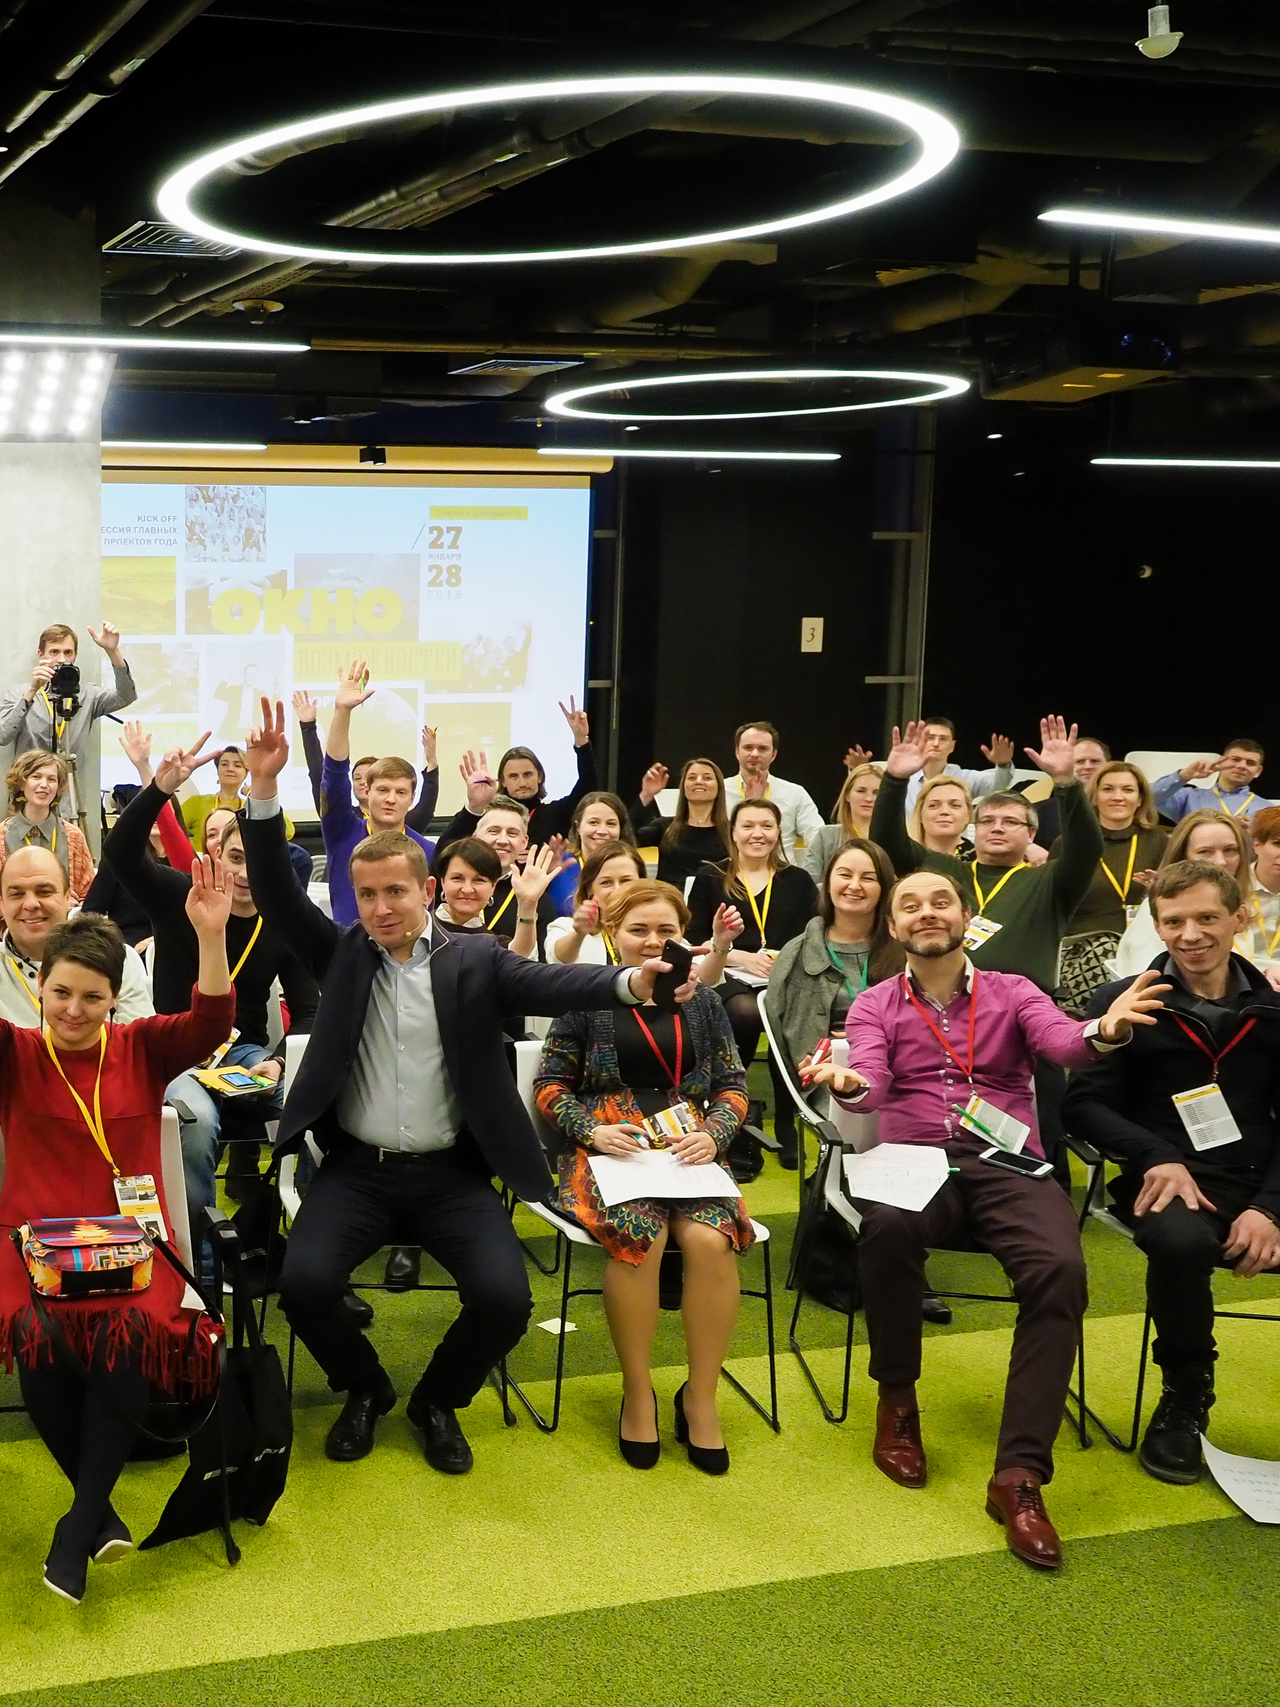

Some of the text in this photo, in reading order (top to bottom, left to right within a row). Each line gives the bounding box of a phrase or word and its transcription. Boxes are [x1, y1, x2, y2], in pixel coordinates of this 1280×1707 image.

[137, 515, 178, 523] KICK OFF
[100, 526, 178, 534] ЕССИЯ ГЛАВНЫХ
[103, 538, 178, 547] ПРОЕКТОВ ГОДА
[428, 525, 463, 550] 27
[427, 564, 463, 588] 28
[426, 590, 463, 600] 2018
[210, 587, 404, 635] ОКНО
[806, 627, 816, 643] 3
